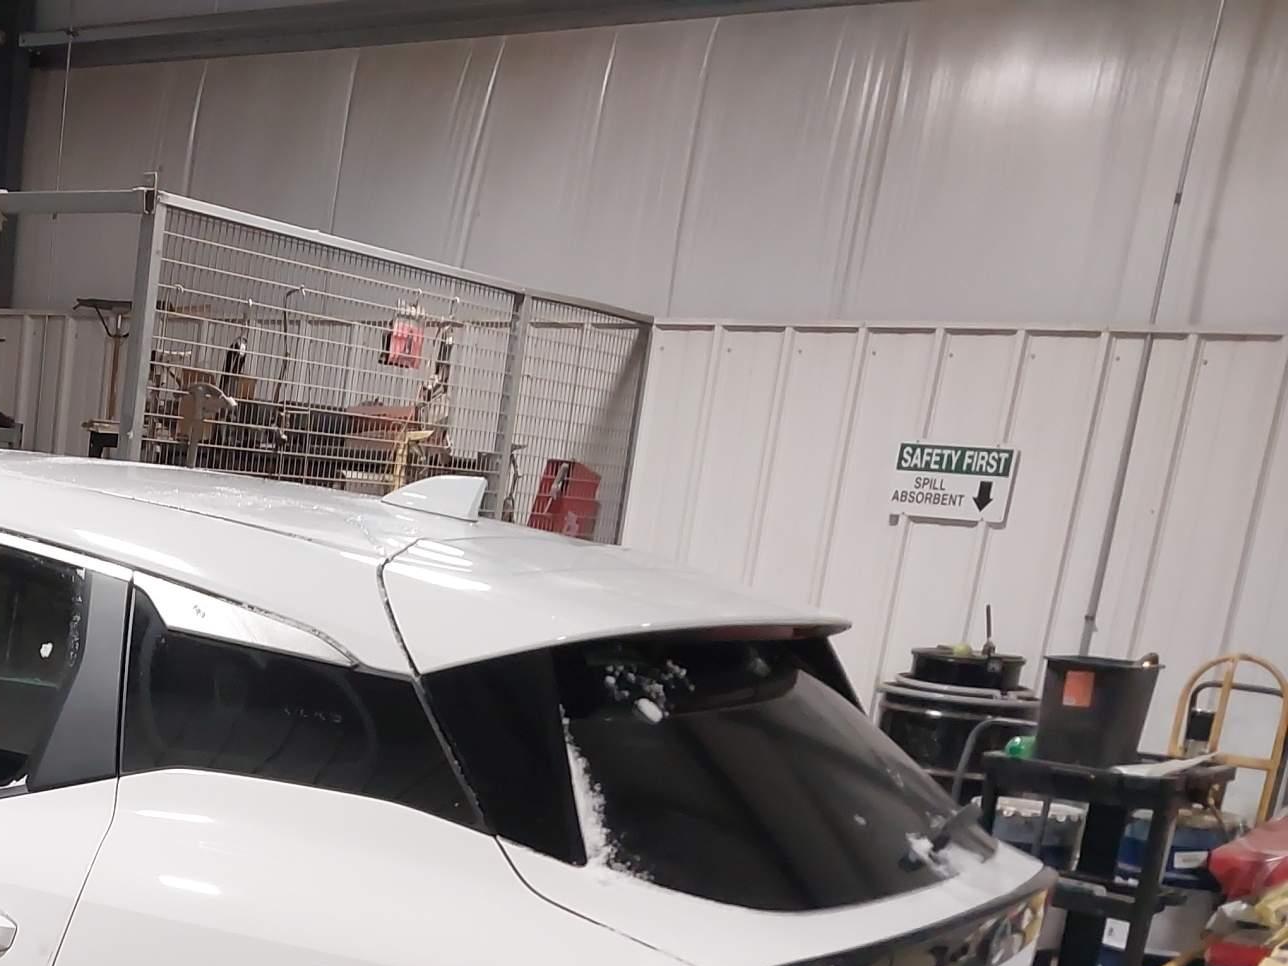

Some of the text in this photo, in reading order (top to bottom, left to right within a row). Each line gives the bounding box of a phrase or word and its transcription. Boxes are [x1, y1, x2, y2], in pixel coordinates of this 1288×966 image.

[901, 446, 1010, 474] SAFETY FIRST
[914, 476, 946, 491] SPILL
[891, 489, 965, 507] ABSORBENT
